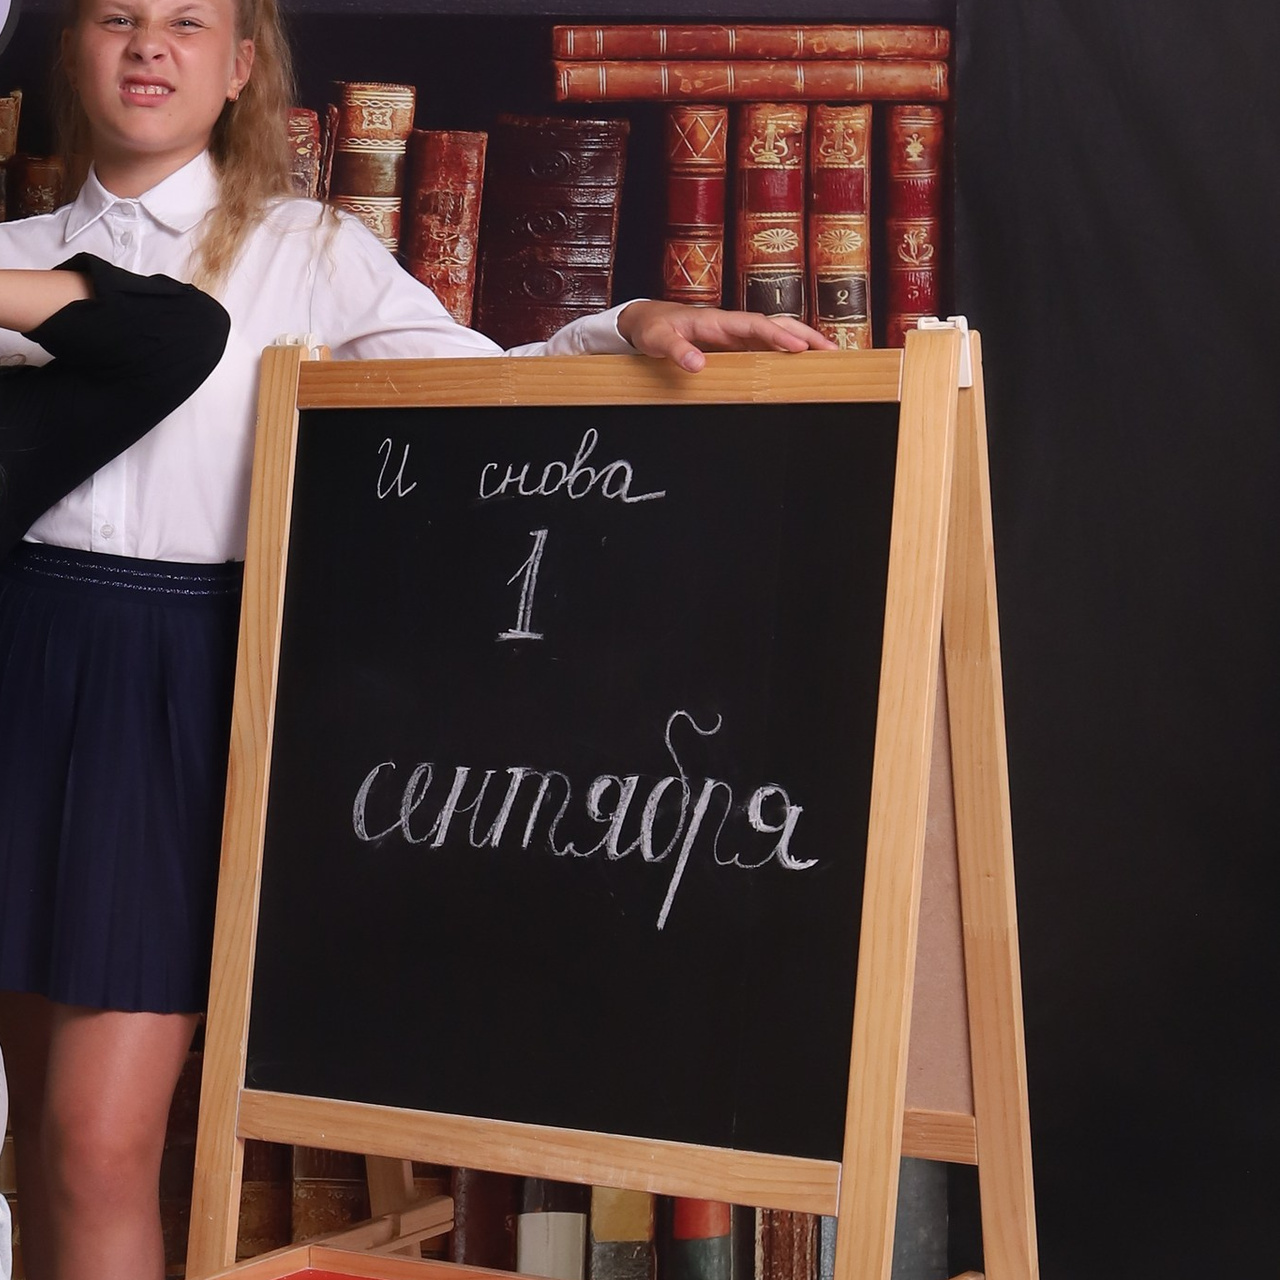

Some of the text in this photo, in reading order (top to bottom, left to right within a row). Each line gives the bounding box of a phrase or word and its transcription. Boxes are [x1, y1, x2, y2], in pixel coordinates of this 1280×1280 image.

[774, 288, 783, 306] 1
[836, 288, 850, 306] 2
[376, 427, 666, 503] И снова
[494, 528, 549, 642] 1
[351, 709, 820, 931] сентября
